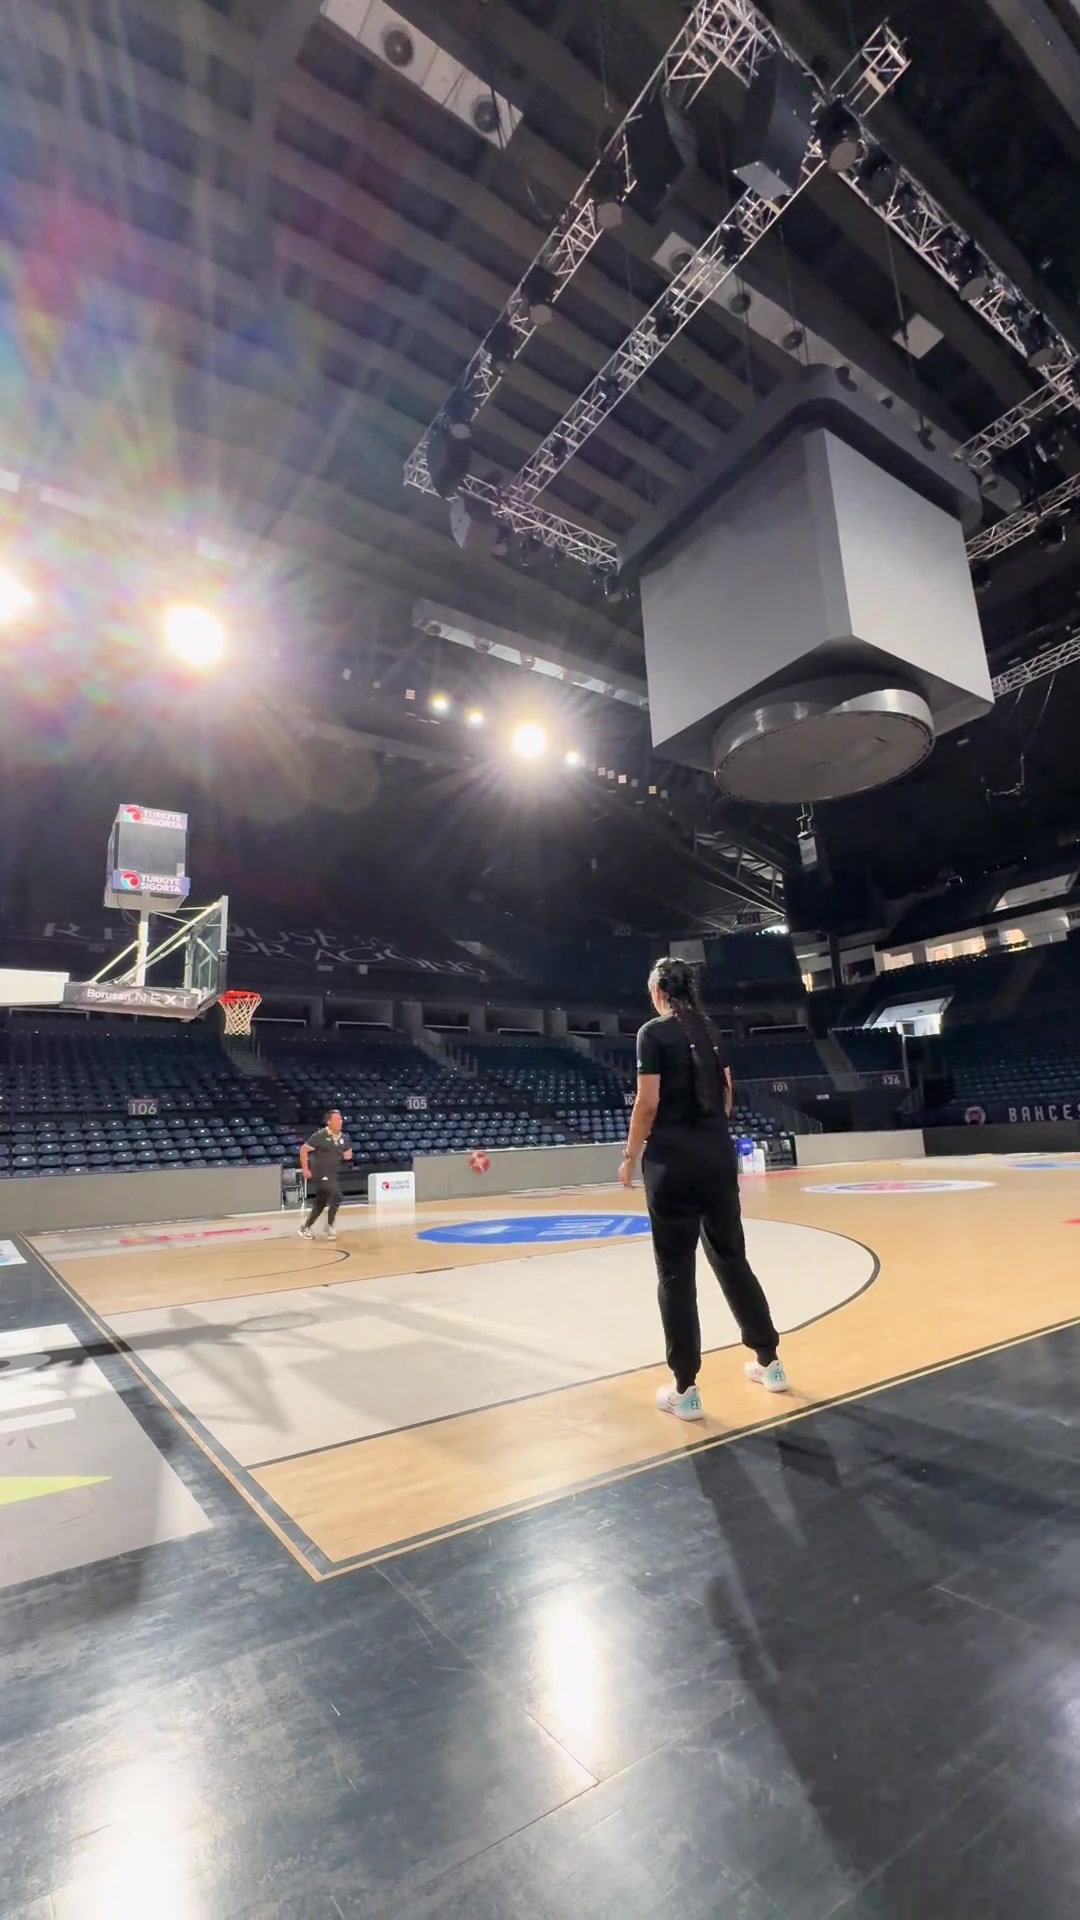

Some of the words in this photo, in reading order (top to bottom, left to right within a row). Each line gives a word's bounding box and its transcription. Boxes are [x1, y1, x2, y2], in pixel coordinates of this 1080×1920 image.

[86, 988, 131, 1001] Borusan
[135, 992, 190, 1007] NEXT
[882, 1075, 901, 1086] 126
[130, 1102, 158, 1116] 106
[408, 1098, 428, 1110] 105
